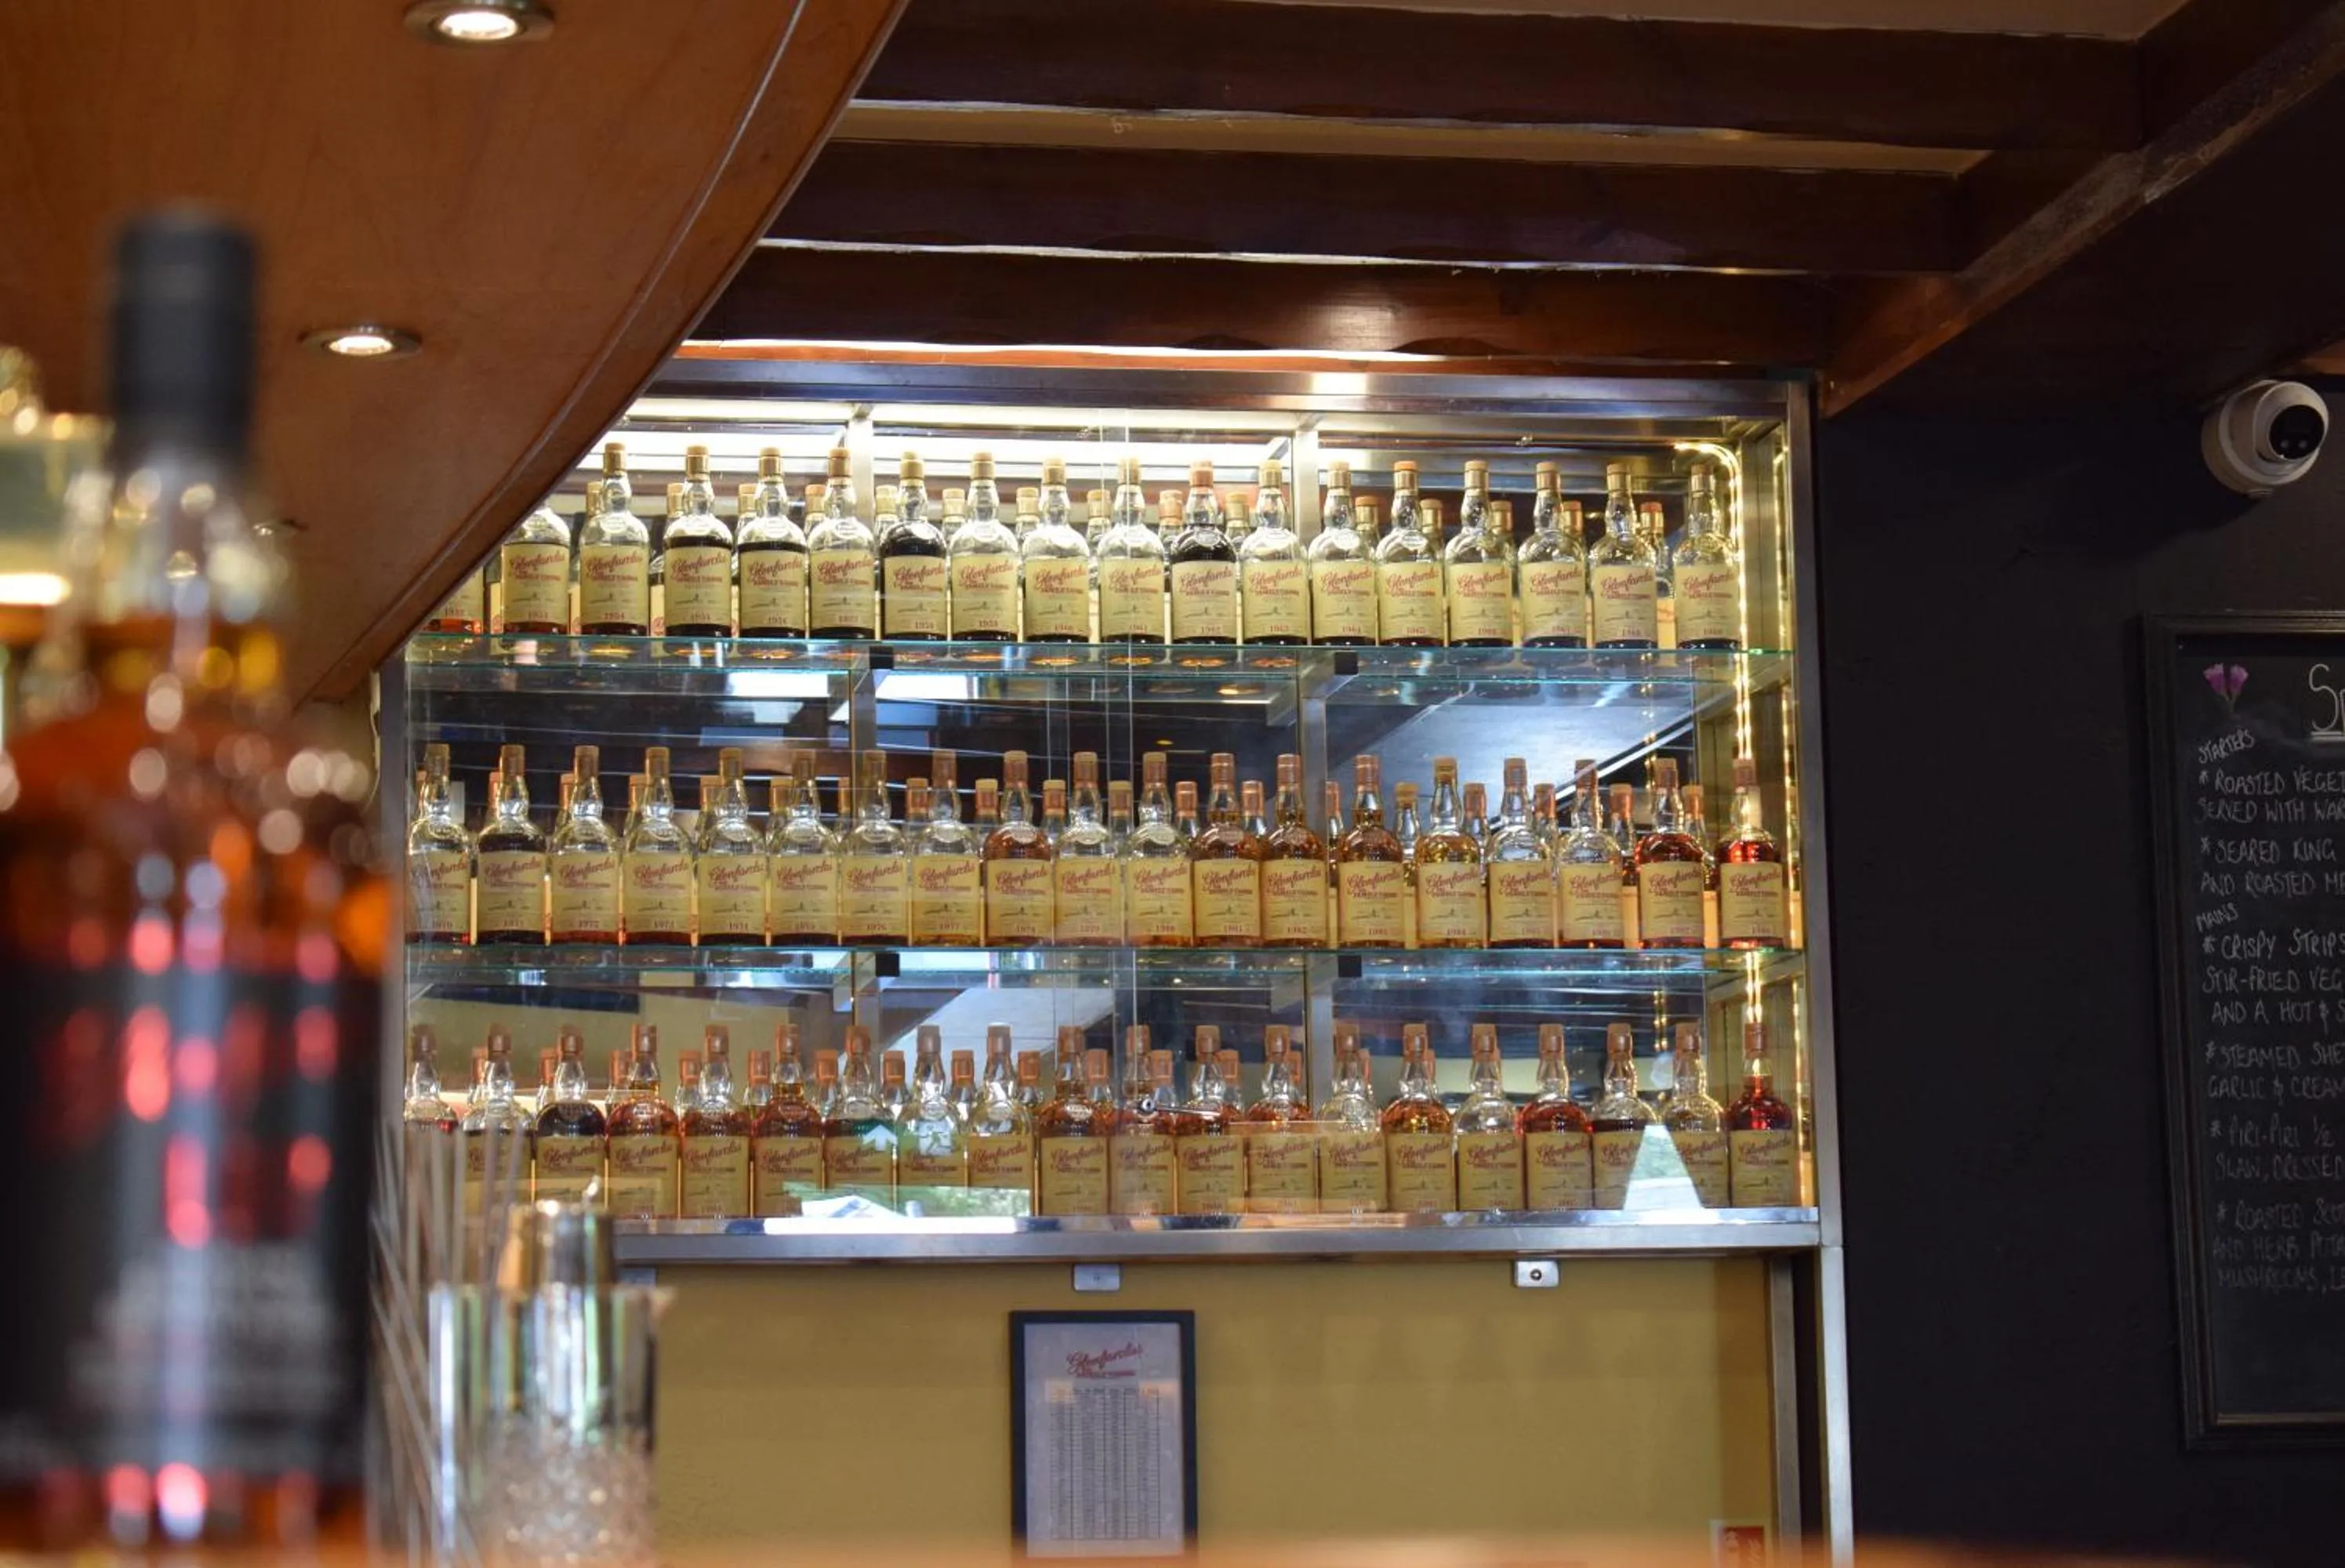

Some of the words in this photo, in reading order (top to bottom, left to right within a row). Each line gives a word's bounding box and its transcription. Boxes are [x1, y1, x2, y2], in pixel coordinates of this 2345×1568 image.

[2214, 768, 2285, 795] ROASTED
[2194, 797, 2258, 824] SERVED
[2264, 797, 2305, 822] WITH
[2215, 838, 2281, 866] SEARED
[2292, 837, 2337, 863] KING
[2201, 872, 2235, 897] AND
[2245, 870, 2315, 898] ROASTED
[2221, 930, 2276, 960] CRISPY
[2202, 964, 2300, 993] STIR-FRIED
[2211, 1000, 2246, 1026] AND
[2254, 1000, 2269, 1025] A
[2278, 1000, 2312, 1024] HOT
[2216, 1044, 2301, 1071] STEAMED
[2207, 1075, 2265, 1101] GARLIC
